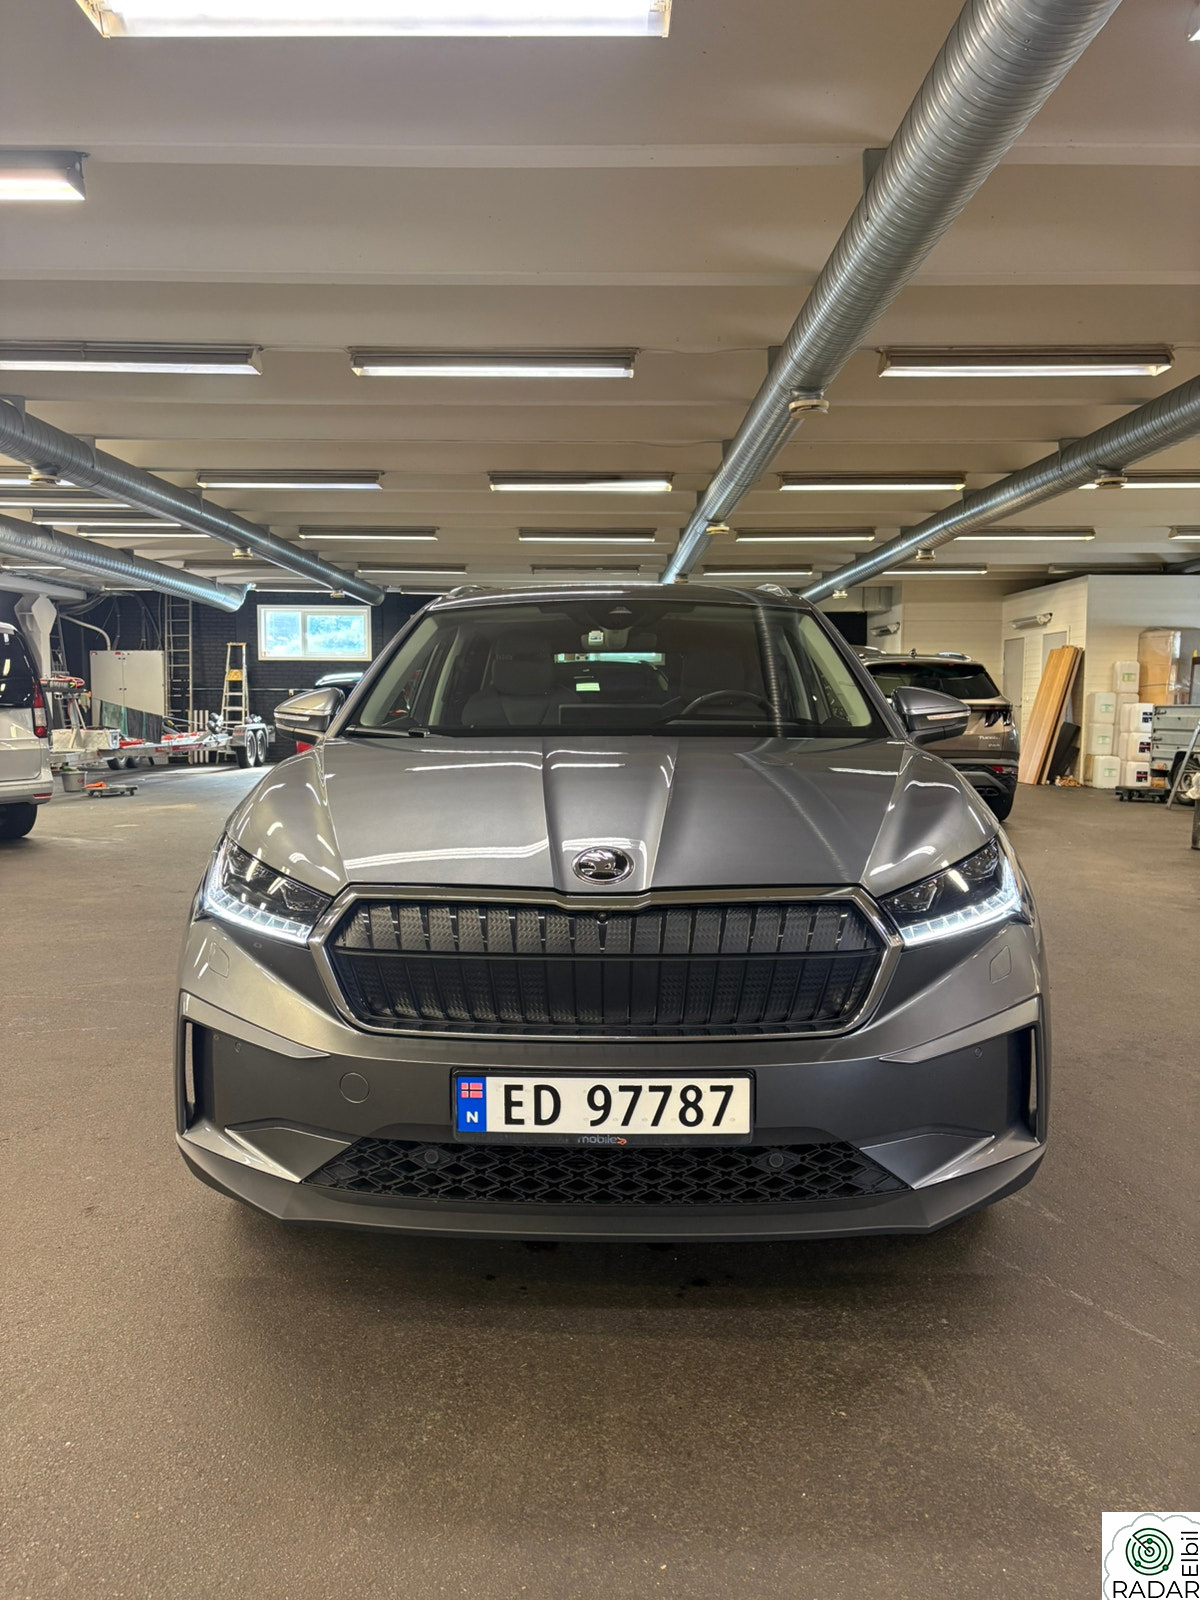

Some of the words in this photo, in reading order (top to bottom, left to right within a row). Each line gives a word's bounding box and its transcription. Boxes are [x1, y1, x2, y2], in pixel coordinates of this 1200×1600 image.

[466, 1111, 479, 1123] N
[504, 1085, 561, 1125] ED
[587, 1085, 733, 1127] 97787
